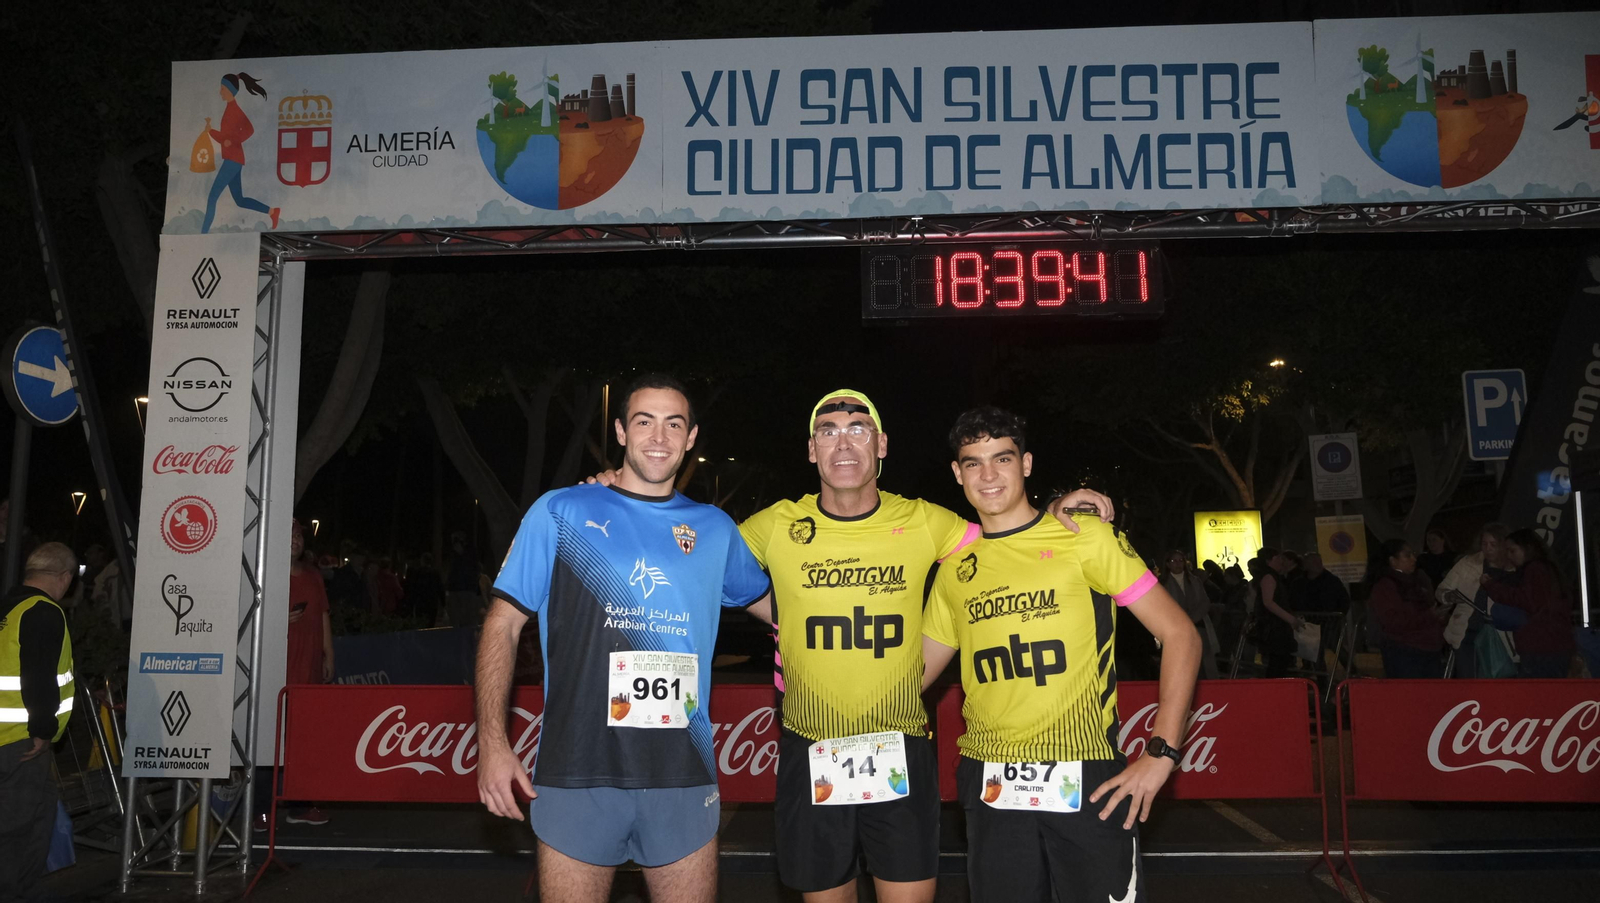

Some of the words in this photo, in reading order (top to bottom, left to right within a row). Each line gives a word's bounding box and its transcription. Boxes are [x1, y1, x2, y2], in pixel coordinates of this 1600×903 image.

[681, 69, 780, 128] XIV
[800, 66, 923, 125] SAN
[943, 62, 1281, 123] SILVESTRE
[346, 126, 456, 154] ALMERÍA
[372, 154, 429, 169] CIUDAD
[687, 136, 903, 196] CIUDAD
[925, 134, 1002, 191] DE
[1021, 119, 1297, 191] ALMERÍA
[935, 250, 1149, 309] 18:39:41
[167, 308, 240, 320] RENAULT
[166, 321, 189, 330] SYRSA
[190, 320, 239, 330] AUTOMOCION
[163, 379, 232, 390] NISSAN
[1473, 377, 1509, 428] P
[168, 415, 229, 424] andalmotor.es
[1479, 439, 1515, 451] PARKIN
[152, 444, 241, 476] Coca-Cola
[801, 561, 824, 571] Centro
[825, 557, 861, 567] Deportivo
[806, 565, 906, 588] SPORTGYM
[868, 587, 879, 596] El
[979, 585, 1010, 599] Deportivo
[967, 588, 1057, 624] SPORTGYM
[603, 616, 646, 632] Arabian
[649, 621, 688, 637] Centres
[1021, 613, 1032, 623] El
[805, 606, 904, 659] mtp
[143, 655, 198, 671] Almericar
[633, 653, 646, 663] XIV
[647, 654, 663, 663] SAN
[973, 633, 1067, 687] mtp
[337, 669, 392, 685] MIENTO
[632, 677, 681, 701] 961
[1427, 699, 1600, 774] Coca-Co
[134, 746, 212, 759] RENAULT
[133, 760, 158, 769] SYRSA
[159, 760, 210, 770] AUTOMOCION
[841, 755, 877, 779] 14
[1003, 761, 1058, 782] 657
